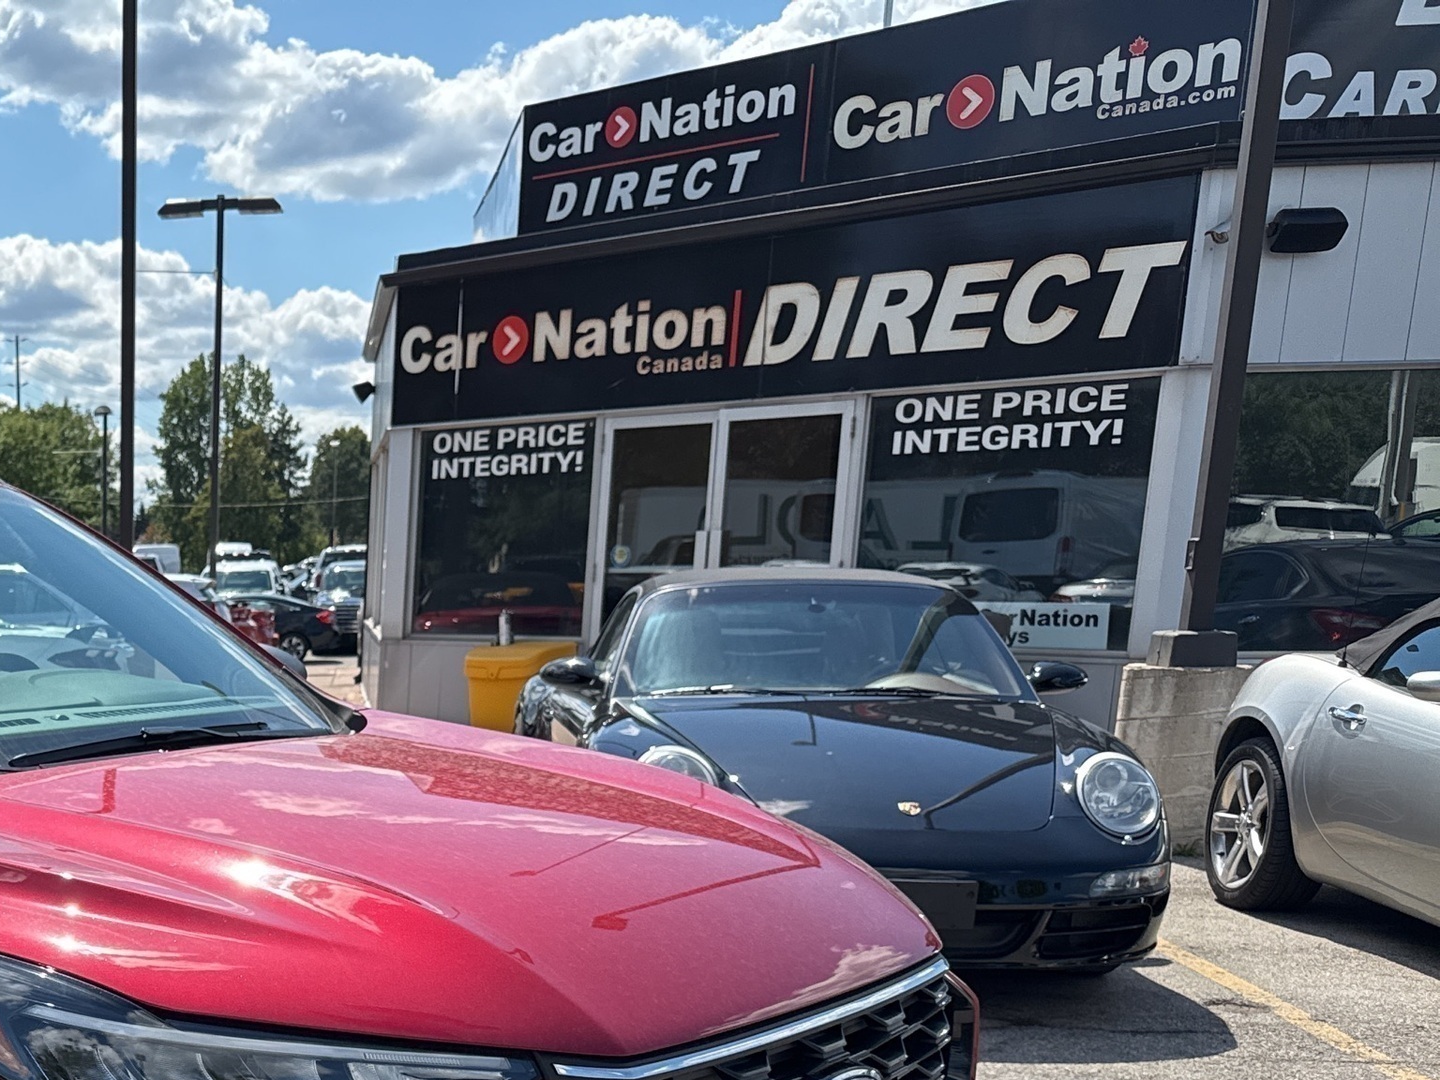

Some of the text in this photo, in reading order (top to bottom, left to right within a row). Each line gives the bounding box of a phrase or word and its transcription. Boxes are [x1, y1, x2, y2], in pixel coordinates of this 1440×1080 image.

[833, 37, 1242, 150] Car Nation
[1096, 84, 1236, 120] Canada.com
[1279, 52, 1440, 119] CAR
[529, 83, 796, 163] Car Nation
[545, 149, 761, 223] DIRECT
[400, 240, 1188, 375] Car Nation DIRECT
[636, 351, 723, 376] Canada
[894, 384, 1130, 425] ONE PRICE
[432, 422, 586, 454] ONE PRICE
[891, 418, 1125, 456] INTEGRITY!
[431, 449, 584, 480] INTEGRITY!
